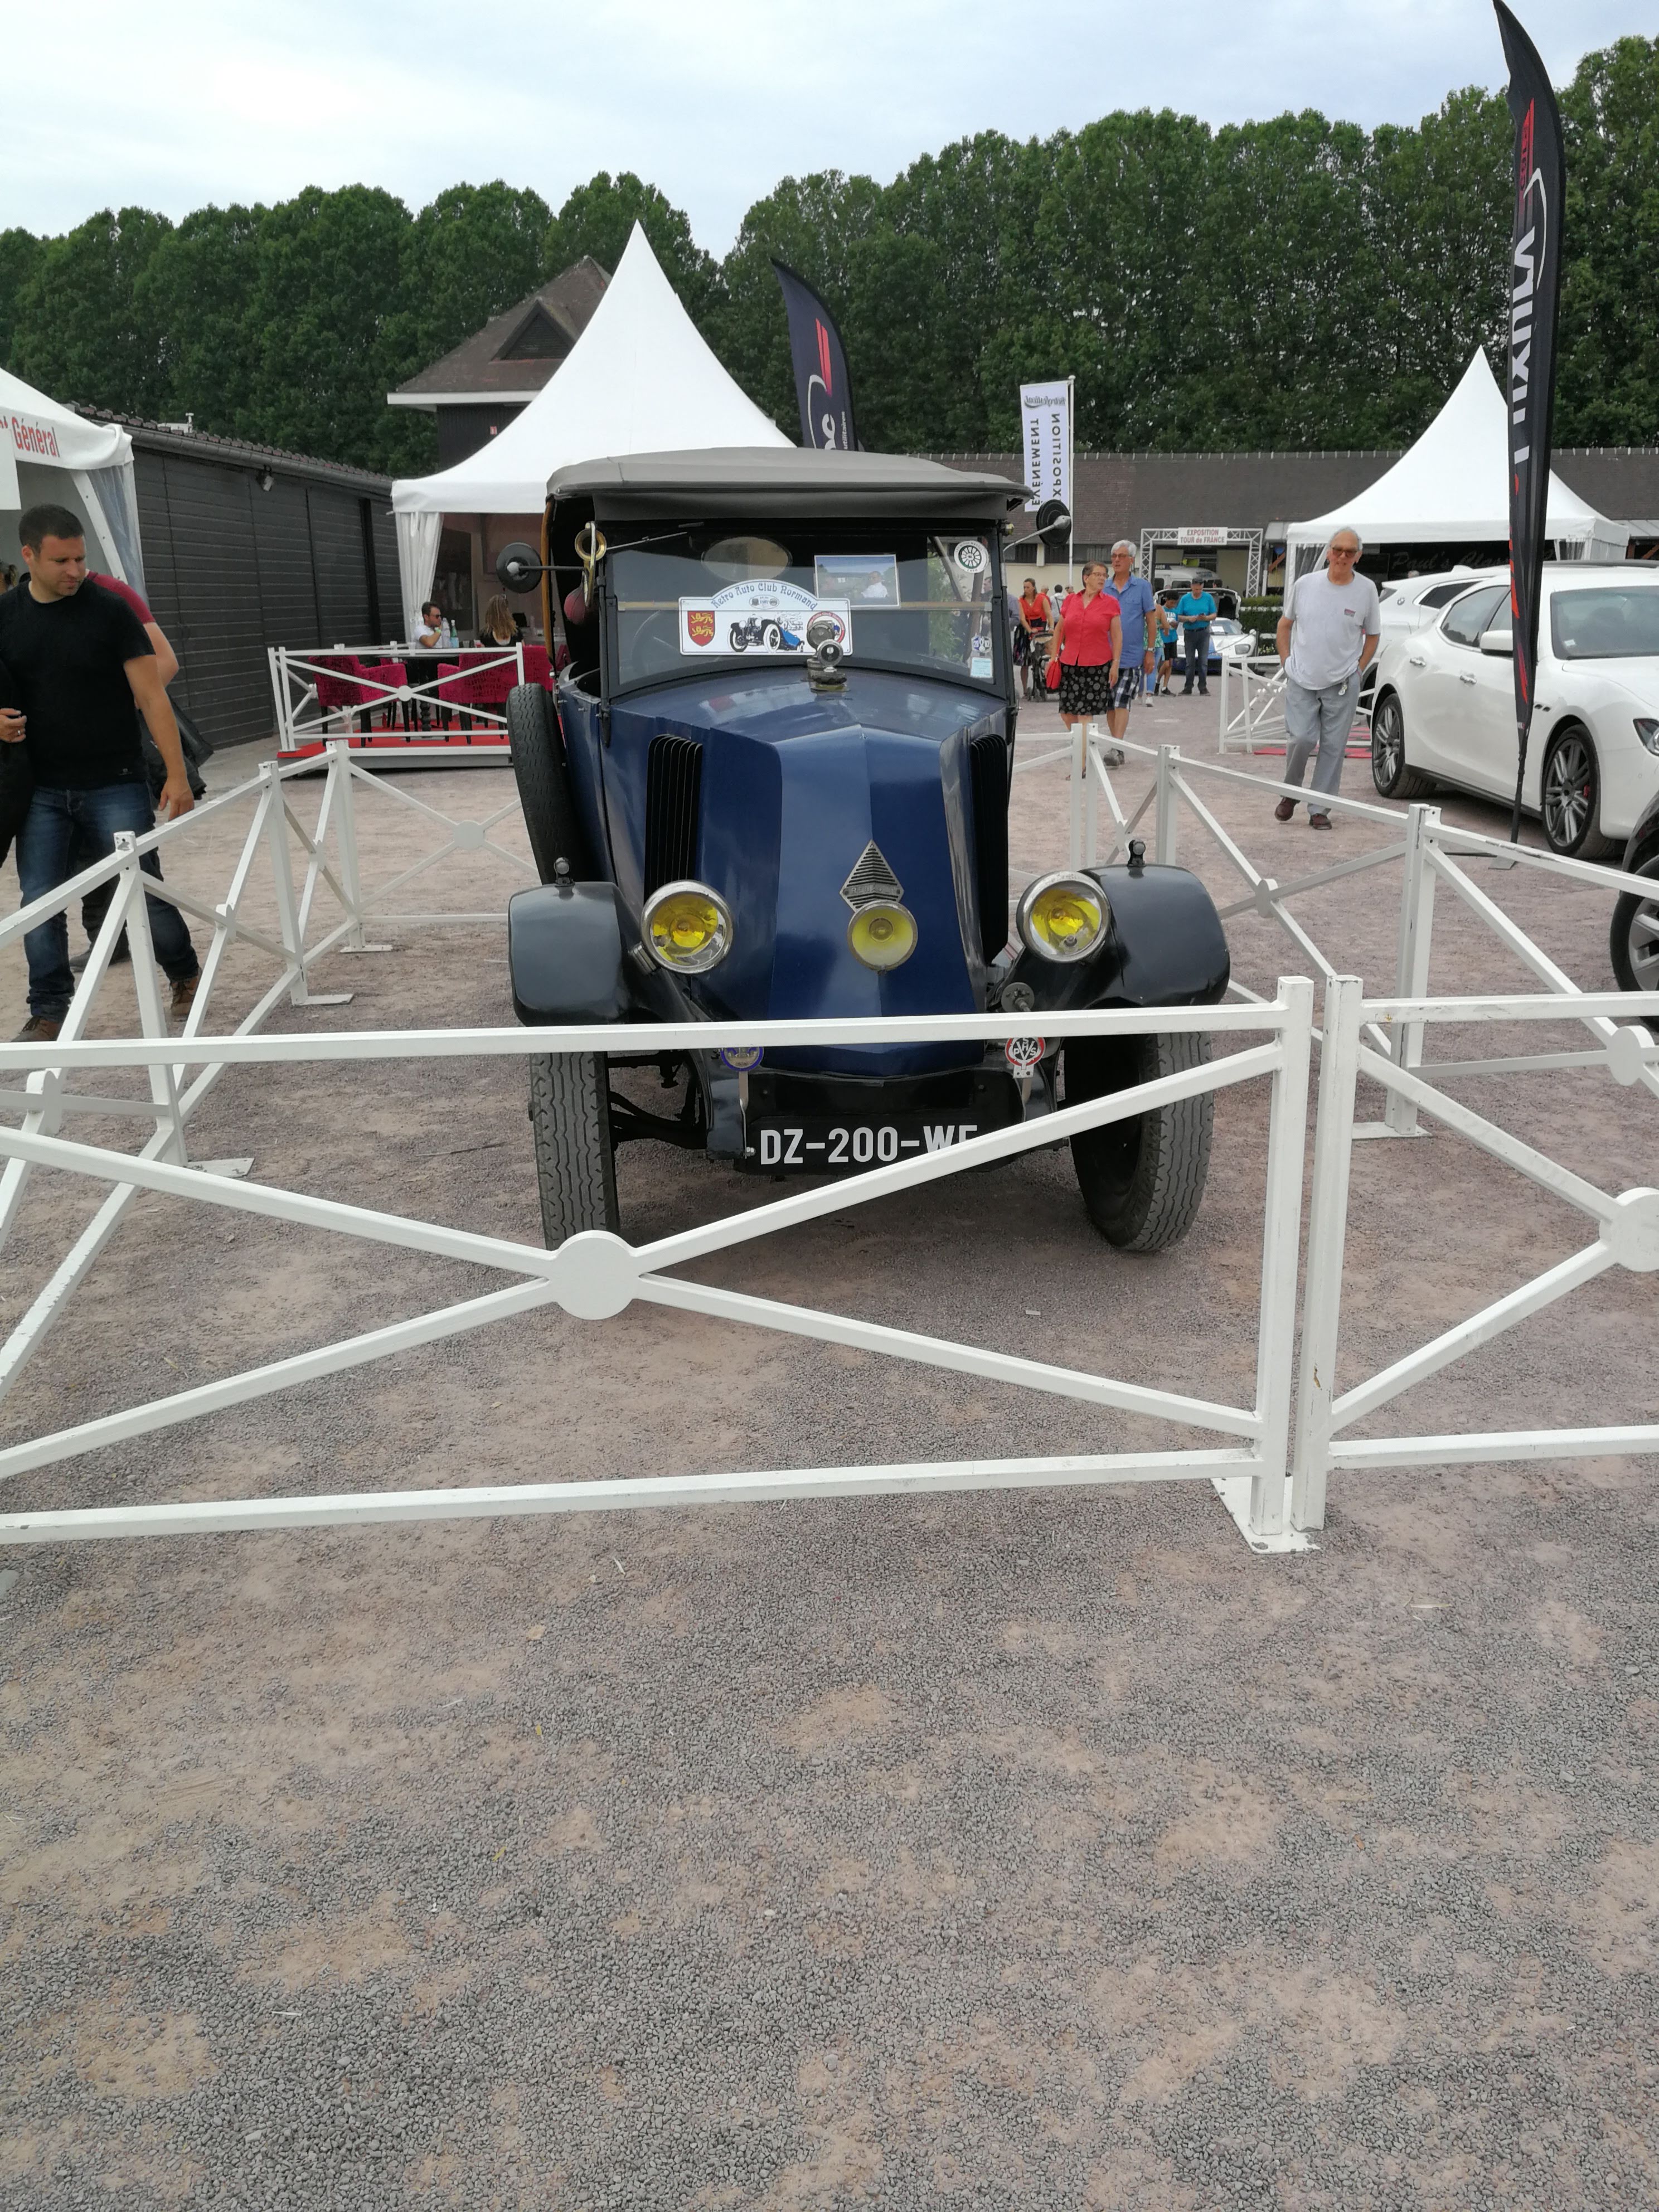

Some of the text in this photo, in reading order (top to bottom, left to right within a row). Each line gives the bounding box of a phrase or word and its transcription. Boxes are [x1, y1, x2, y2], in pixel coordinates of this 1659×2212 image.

[11, 416, 60, 458] Général
[711, 583, 818, 611] Retro Auto Club Normand
